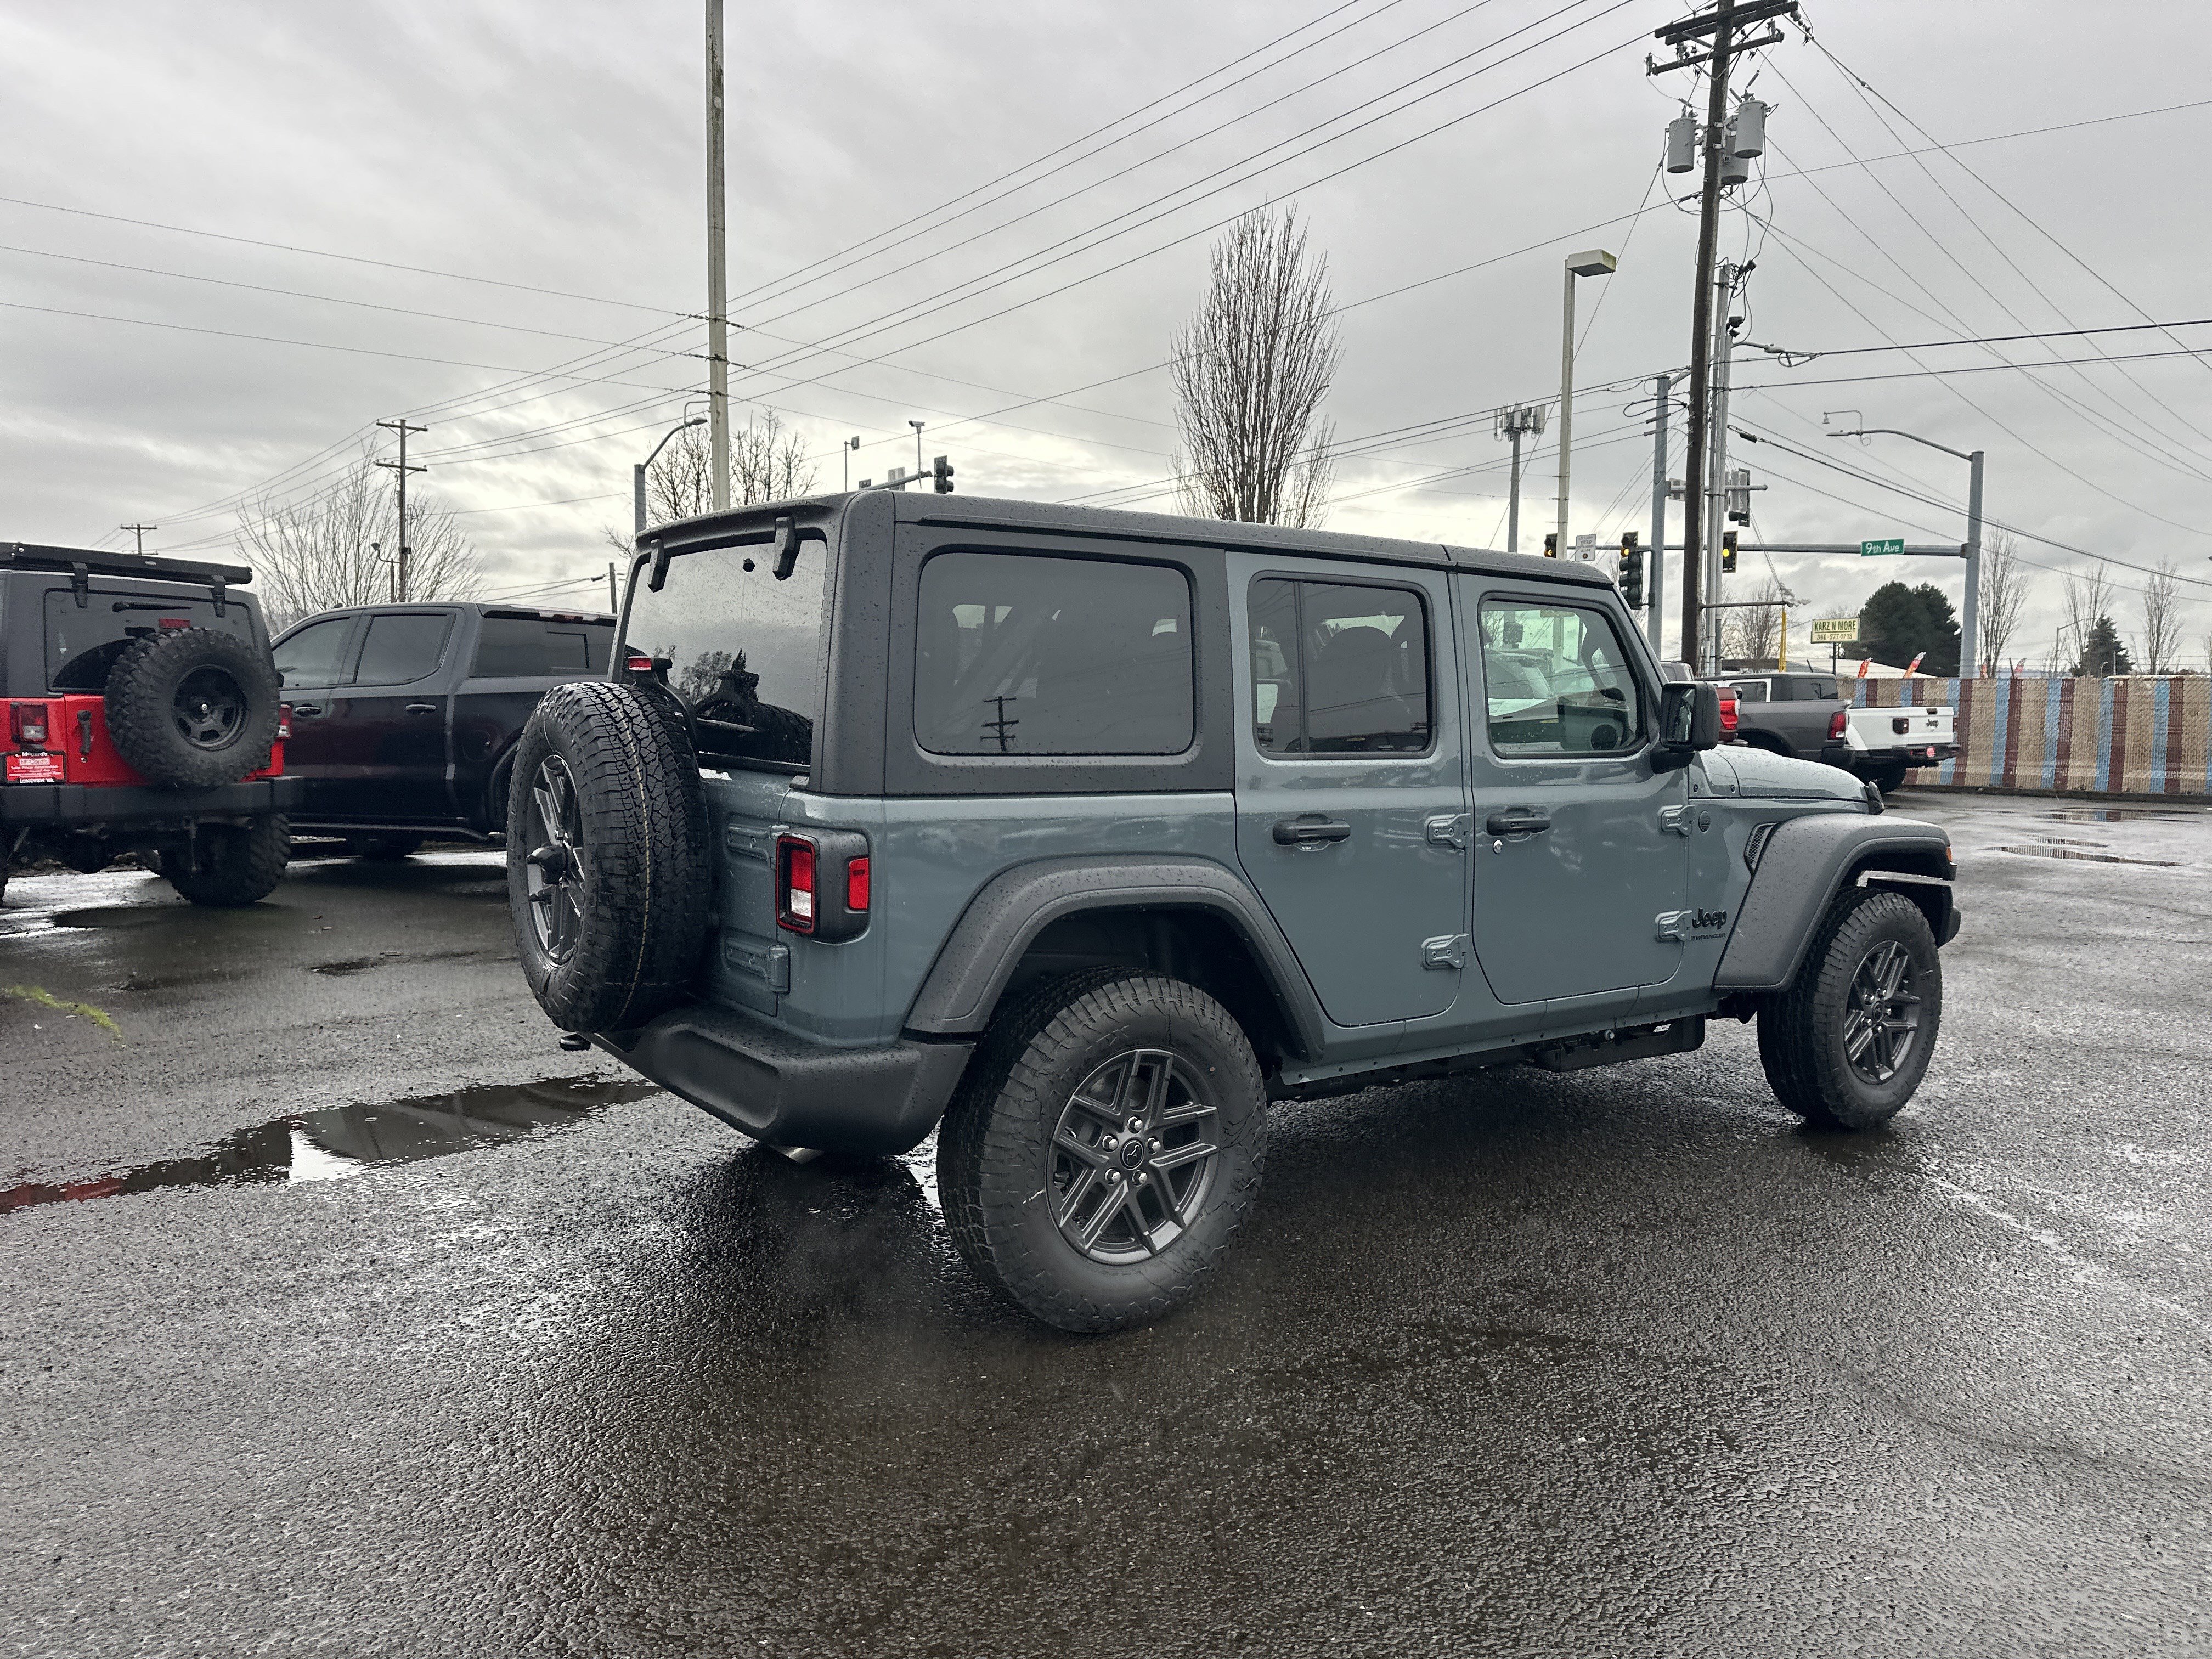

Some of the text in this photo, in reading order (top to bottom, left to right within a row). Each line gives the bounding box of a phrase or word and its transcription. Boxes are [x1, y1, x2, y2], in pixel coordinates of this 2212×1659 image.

[1866, 541, 1900, 554] 9th Ave
[1814, 620, 1856, 631] KARZ N MORE
[1926, 718, 1939, 728] Jeep
[1692, 907, 1728, 929] Jeep
